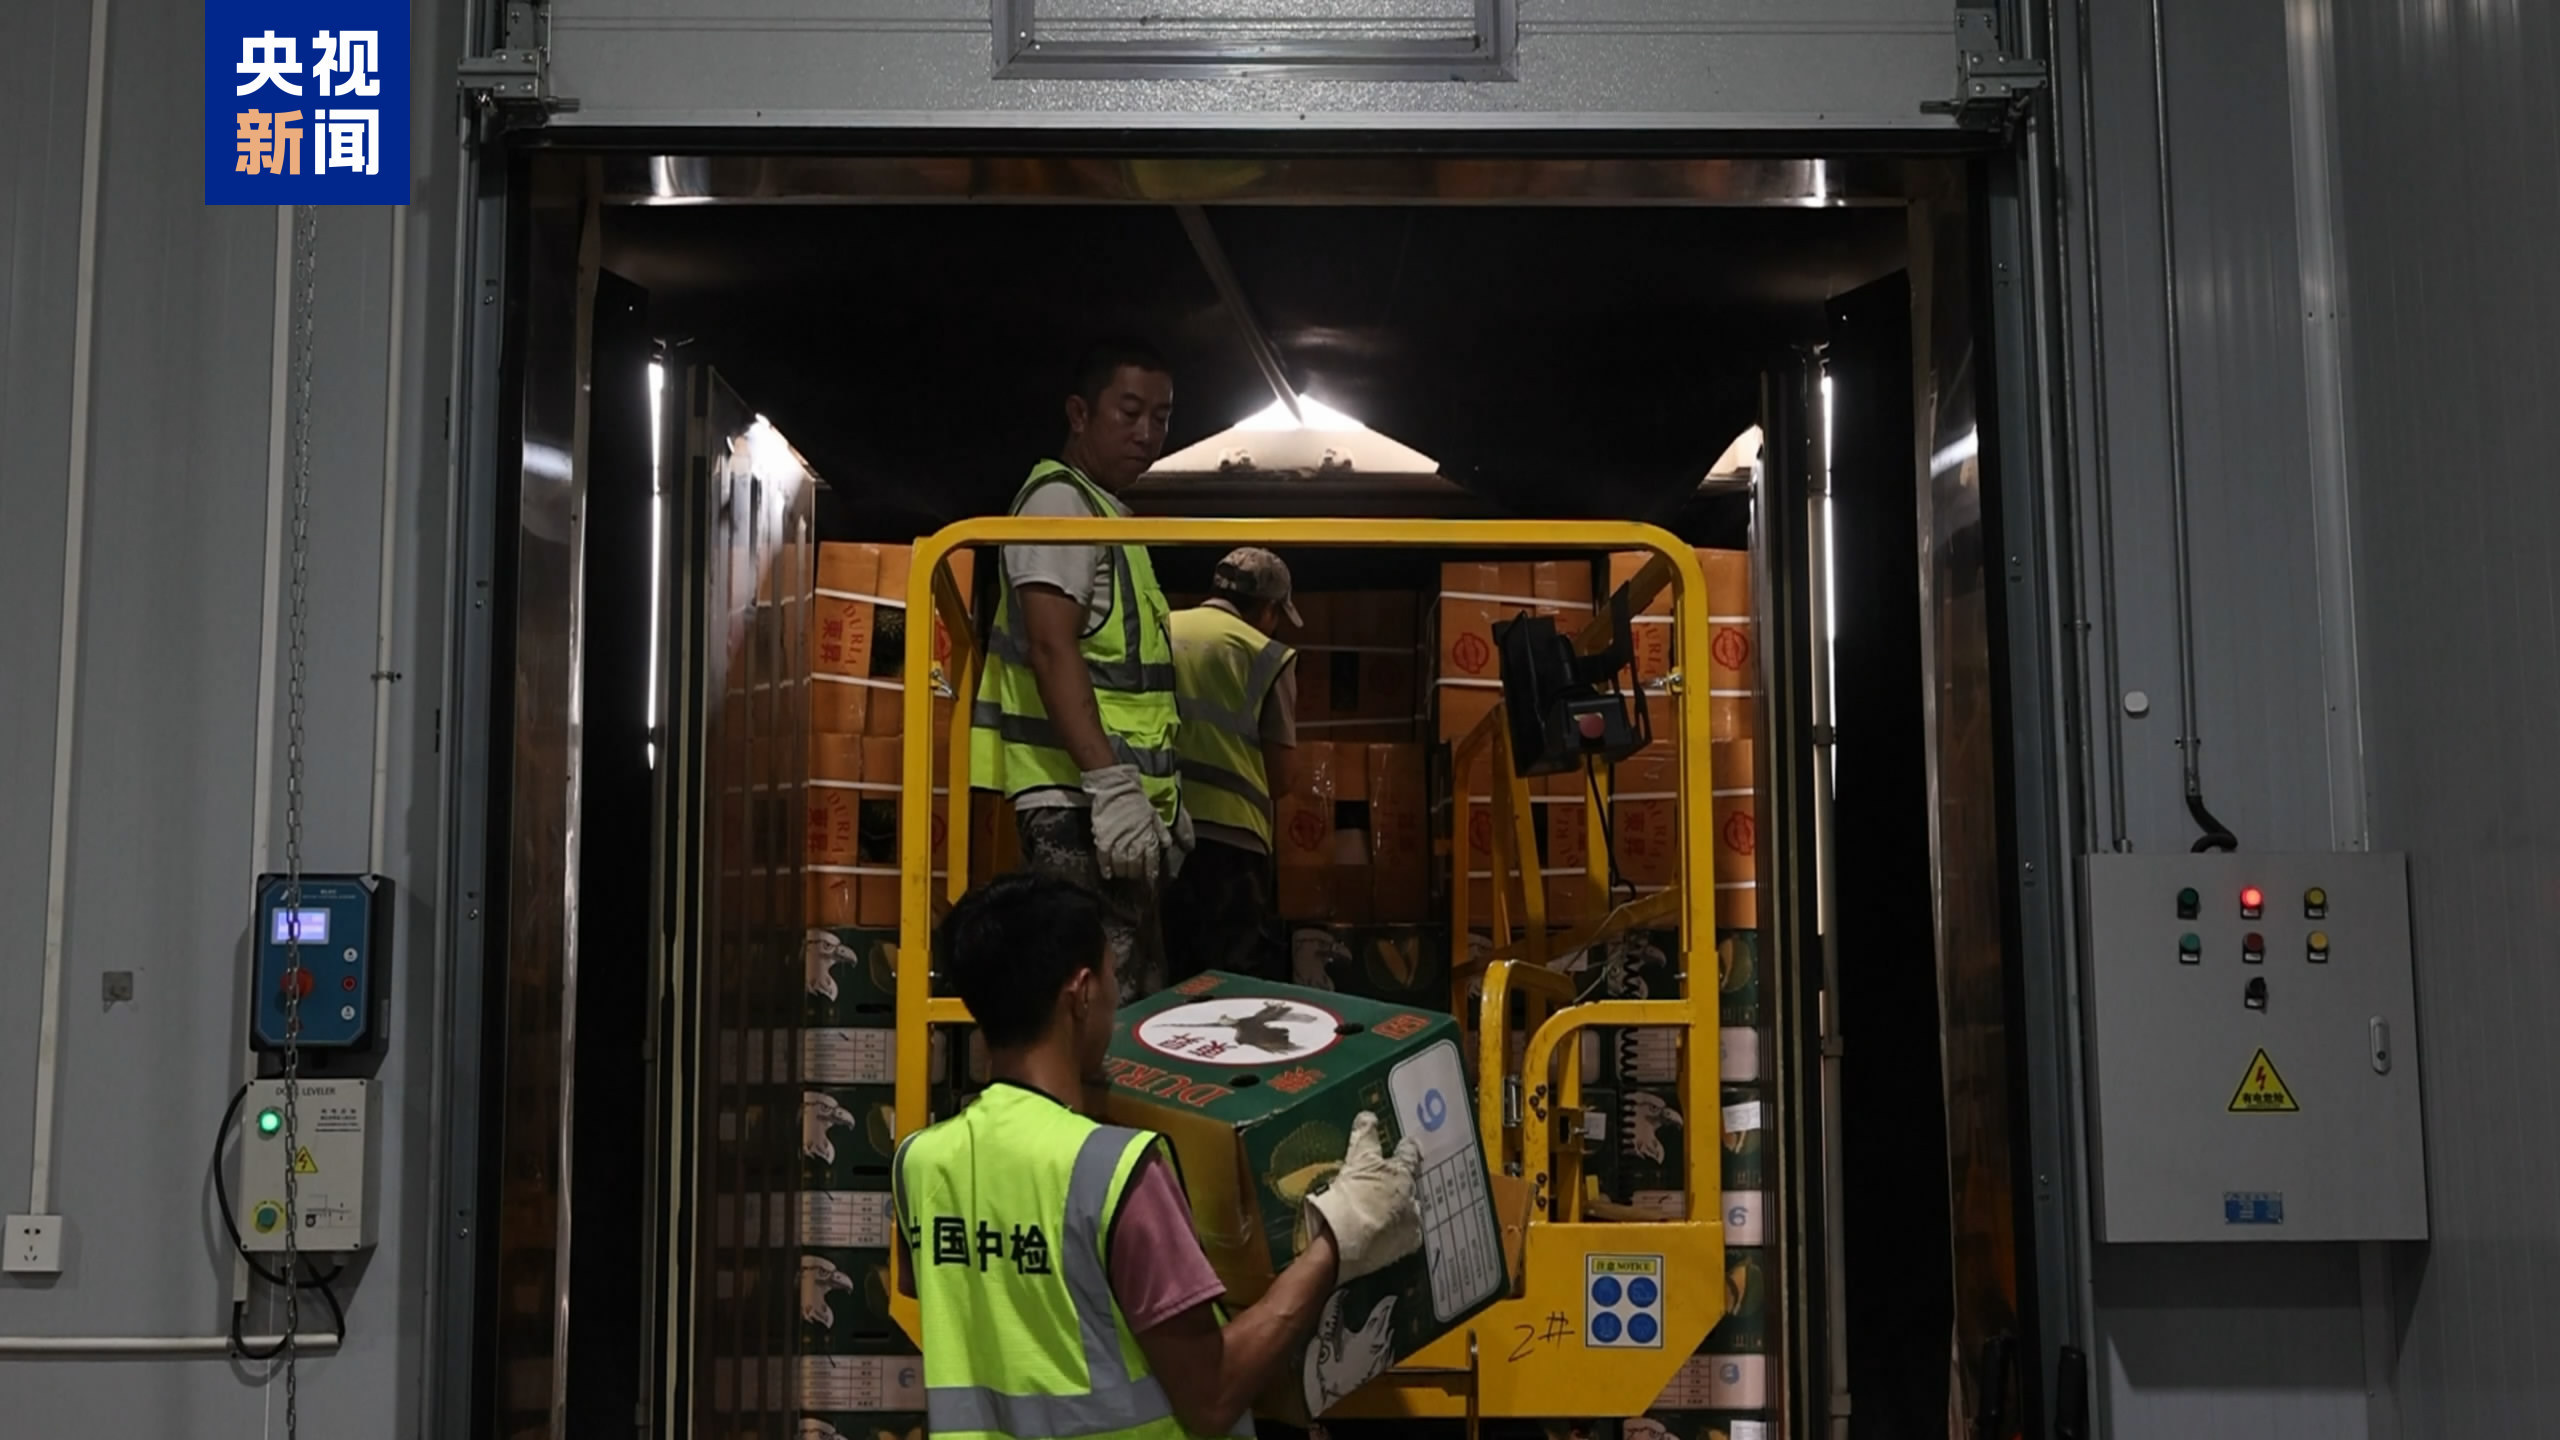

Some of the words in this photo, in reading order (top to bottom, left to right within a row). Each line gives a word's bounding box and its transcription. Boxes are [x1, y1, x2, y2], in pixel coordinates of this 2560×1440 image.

[837, 604, 866, 676] DURIA
[302, 1087, 336, 1097] LEVELER
[1102, 1055, 1235, 1108] DURI
[2243, 1092, 2284, 1105] 有电危险
[1727, 1205, 1749, 1227] 6
[1617, 1261, 1650, 1272] NOTICE
[1507, 1310, 1576, 1363] 2#
